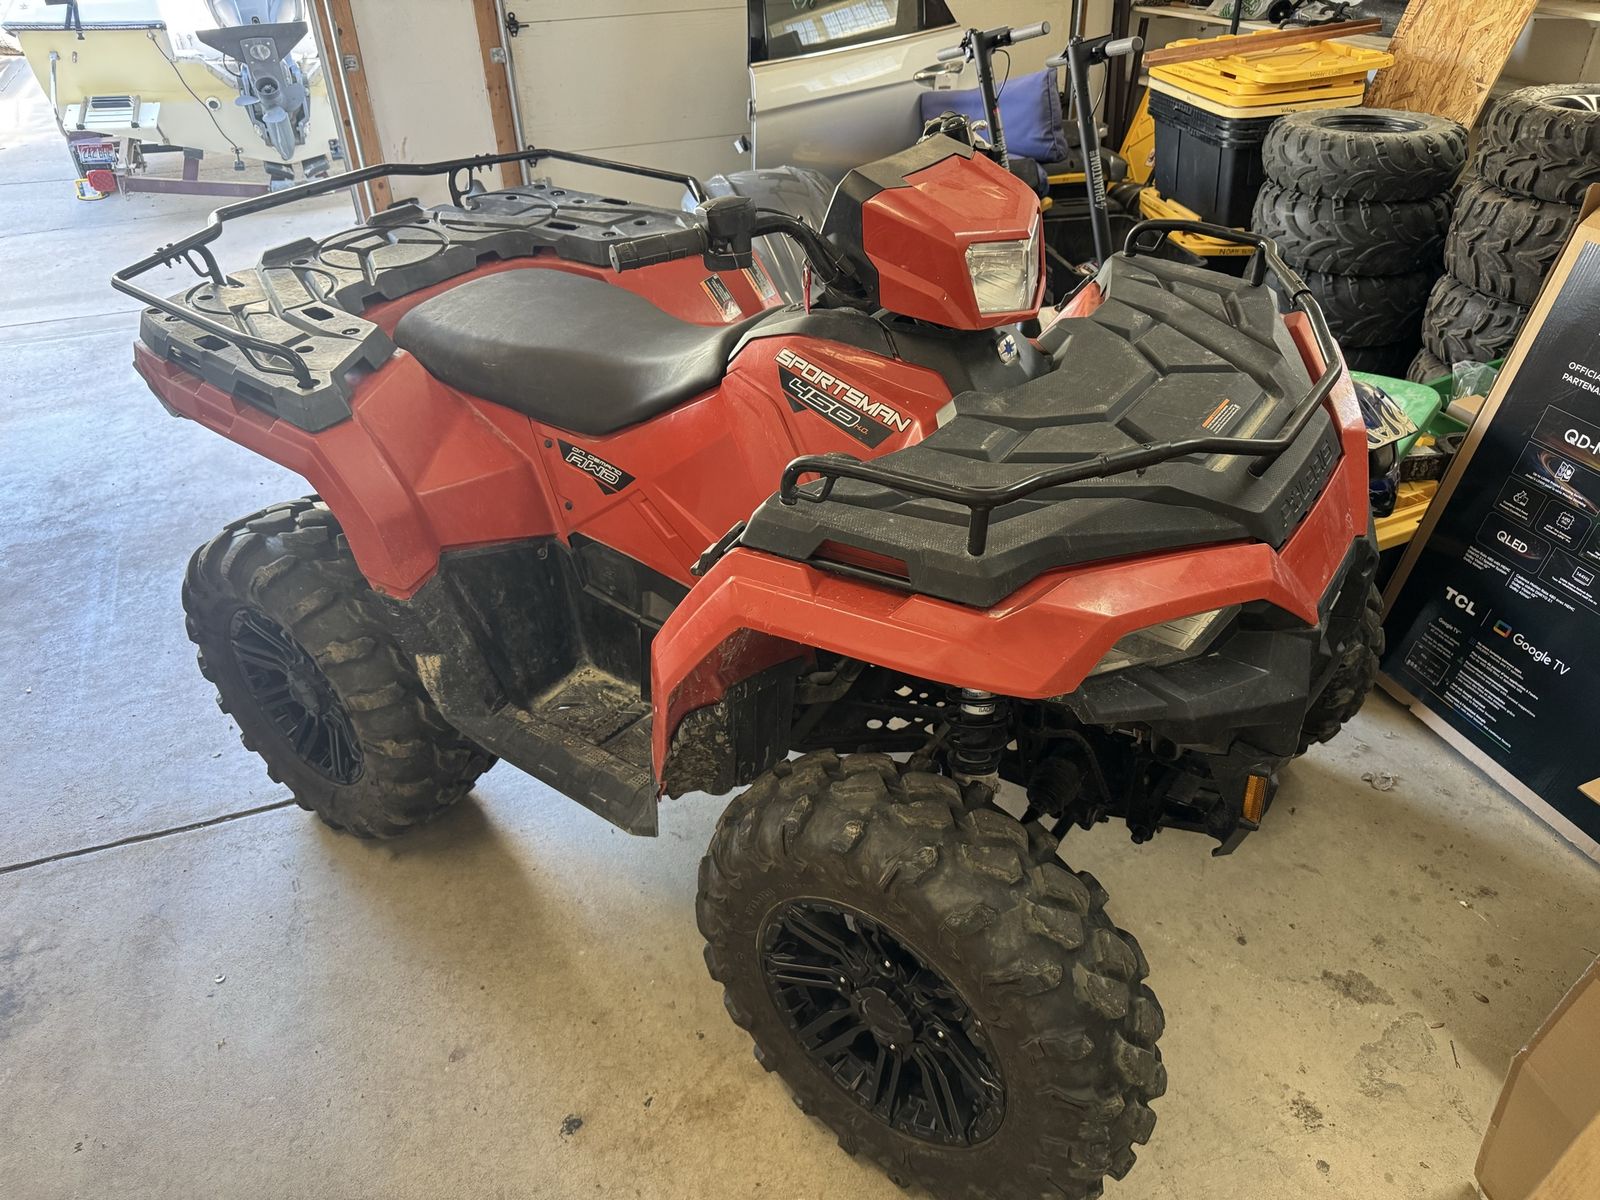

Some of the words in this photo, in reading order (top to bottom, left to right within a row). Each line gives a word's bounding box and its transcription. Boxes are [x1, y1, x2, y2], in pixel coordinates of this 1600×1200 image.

[1090, 156, 1106, 203] PHANTOM
[774, 348, 912, 433] SPORTSMAN
[1561, 372, 1600, 396] PARTENA
[788, 377, 861, 428] 450
[565, 451, 620, 485] AWD
[1497, 530, 1528, 553] QLED
[1446, 586, 1476, 616] TCL
[1438, 617, 1453, 630] Google
[1513, 633, 1552, 665] Google
[1553, 659, 1571, 675] TV
